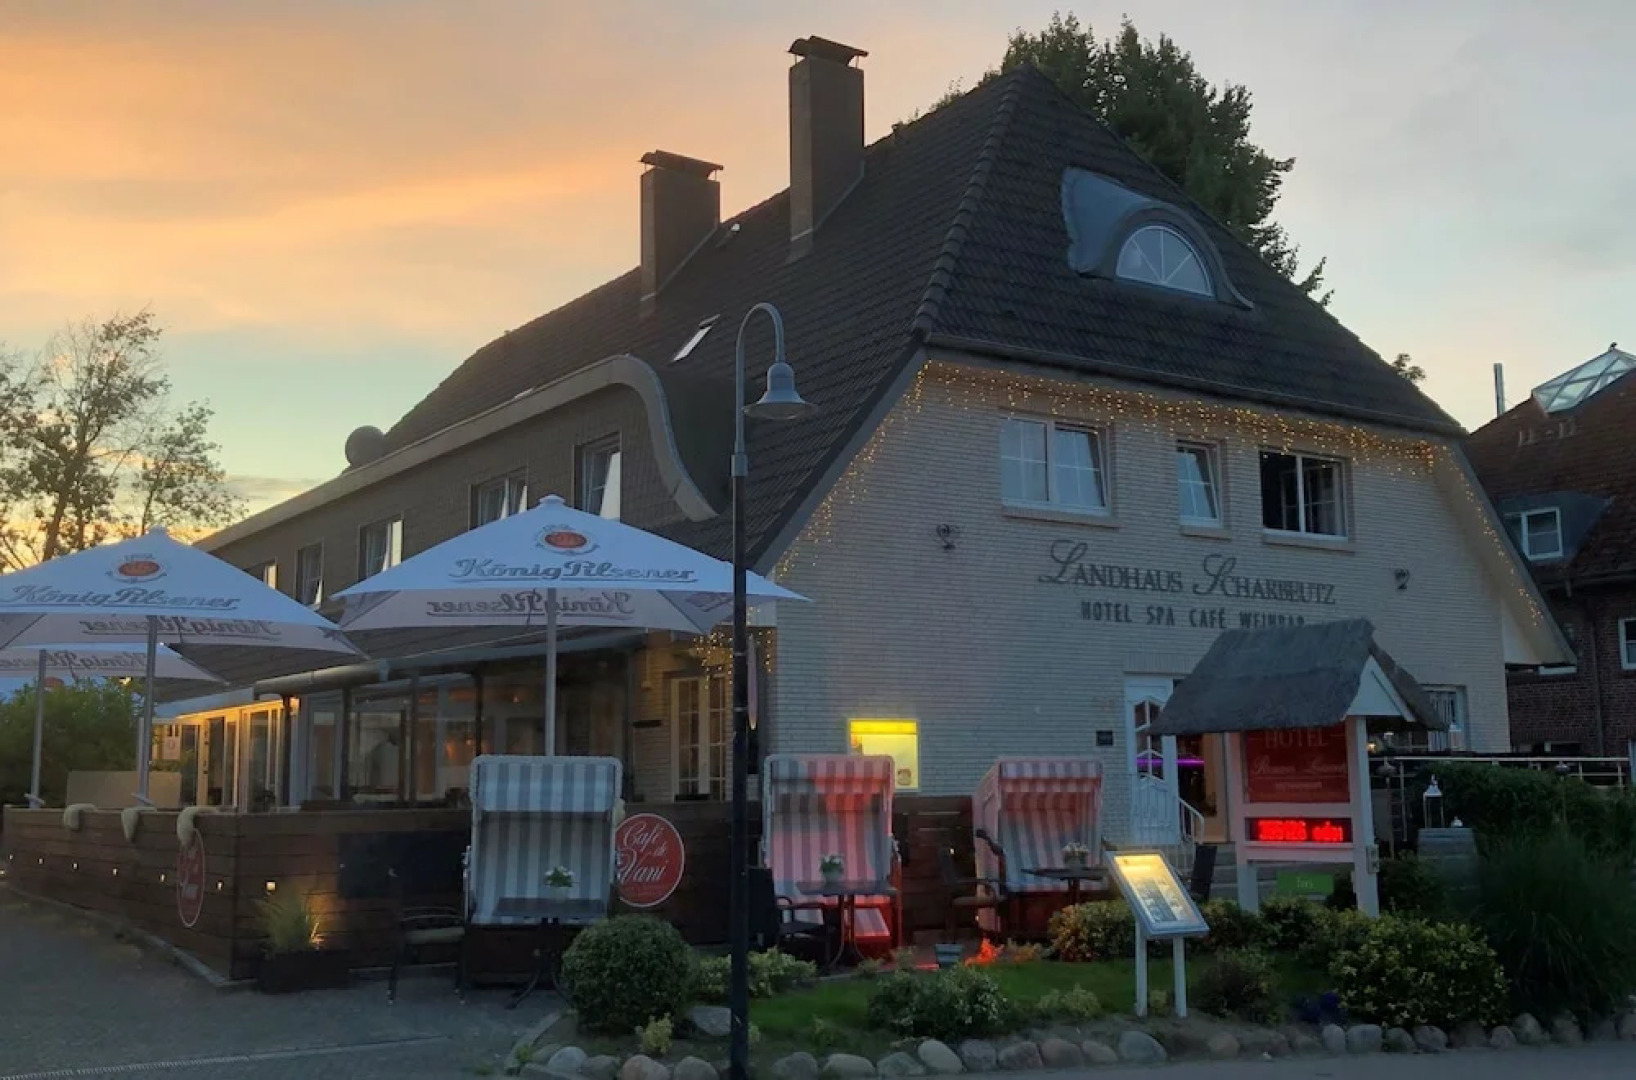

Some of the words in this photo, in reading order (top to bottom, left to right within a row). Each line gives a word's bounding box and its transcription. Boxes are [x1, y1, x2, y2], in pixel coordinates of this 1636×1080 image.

[448, 559, 562, 580] König
[562, 560, 698, 580] Pilsener
[11, 585, 110, 606] König
[110, 586, 240, 607] Pilsener
[1081, 602, 1132, 623] HOTEL
[1146, 603, 1175, 626] SPA
[1190, 606, 1227, 629] CAFÉ
[1265, 728, 1329, 748] HOTEL
